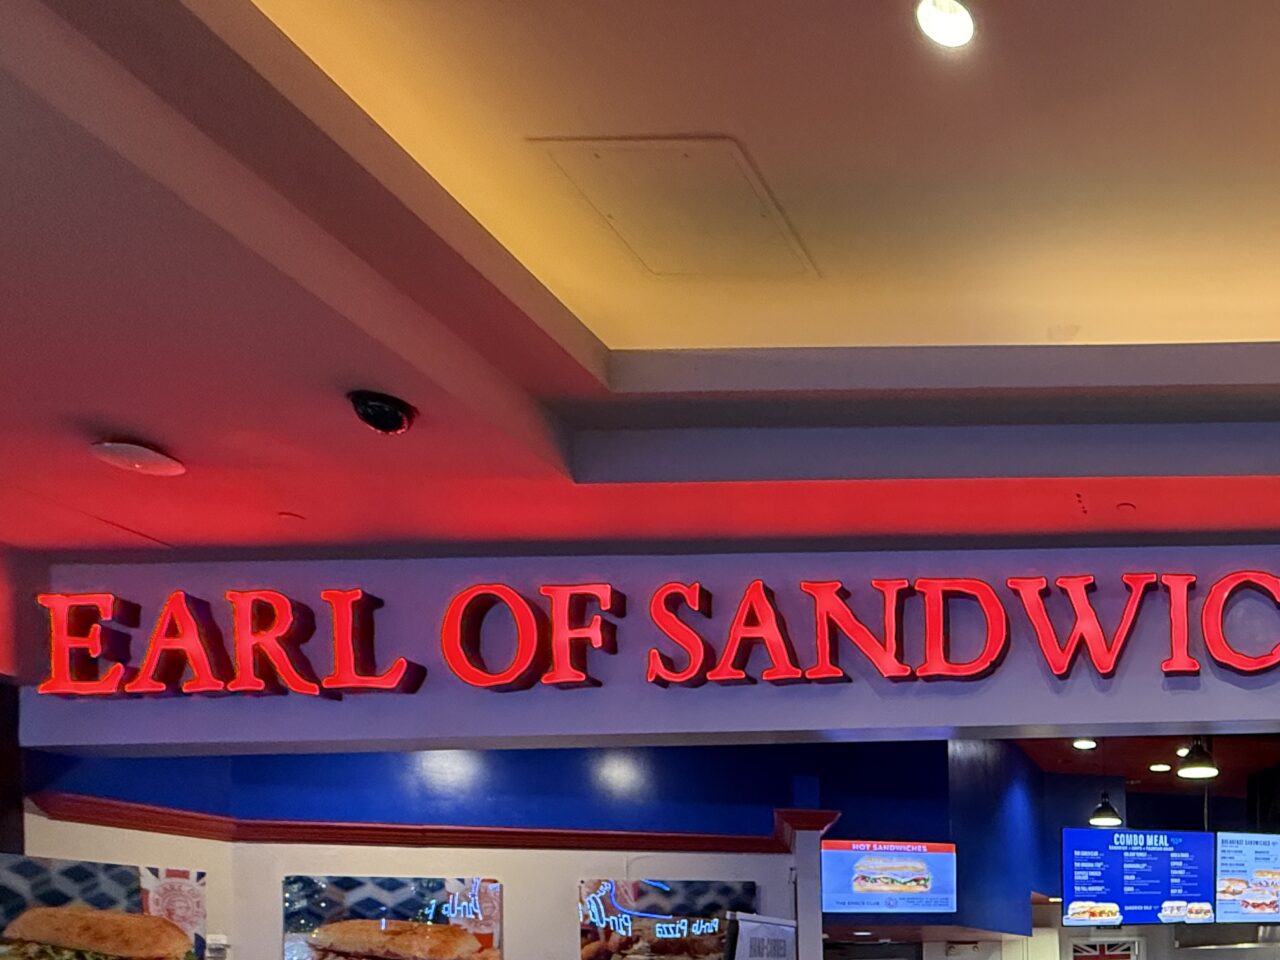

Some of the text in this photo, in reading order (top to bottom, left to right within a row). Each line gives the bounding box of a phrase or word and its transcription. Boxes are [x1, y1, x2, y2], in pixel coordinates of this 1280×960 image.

[37, 588, 409, 696] EARL
[441, 583, 613, 688] OF
[1113, 833, 1145, 846] COMBO
[1146, 834, 1169, 847] MEAL
[852, 843, 928, 853] HOT SANDWICHES
